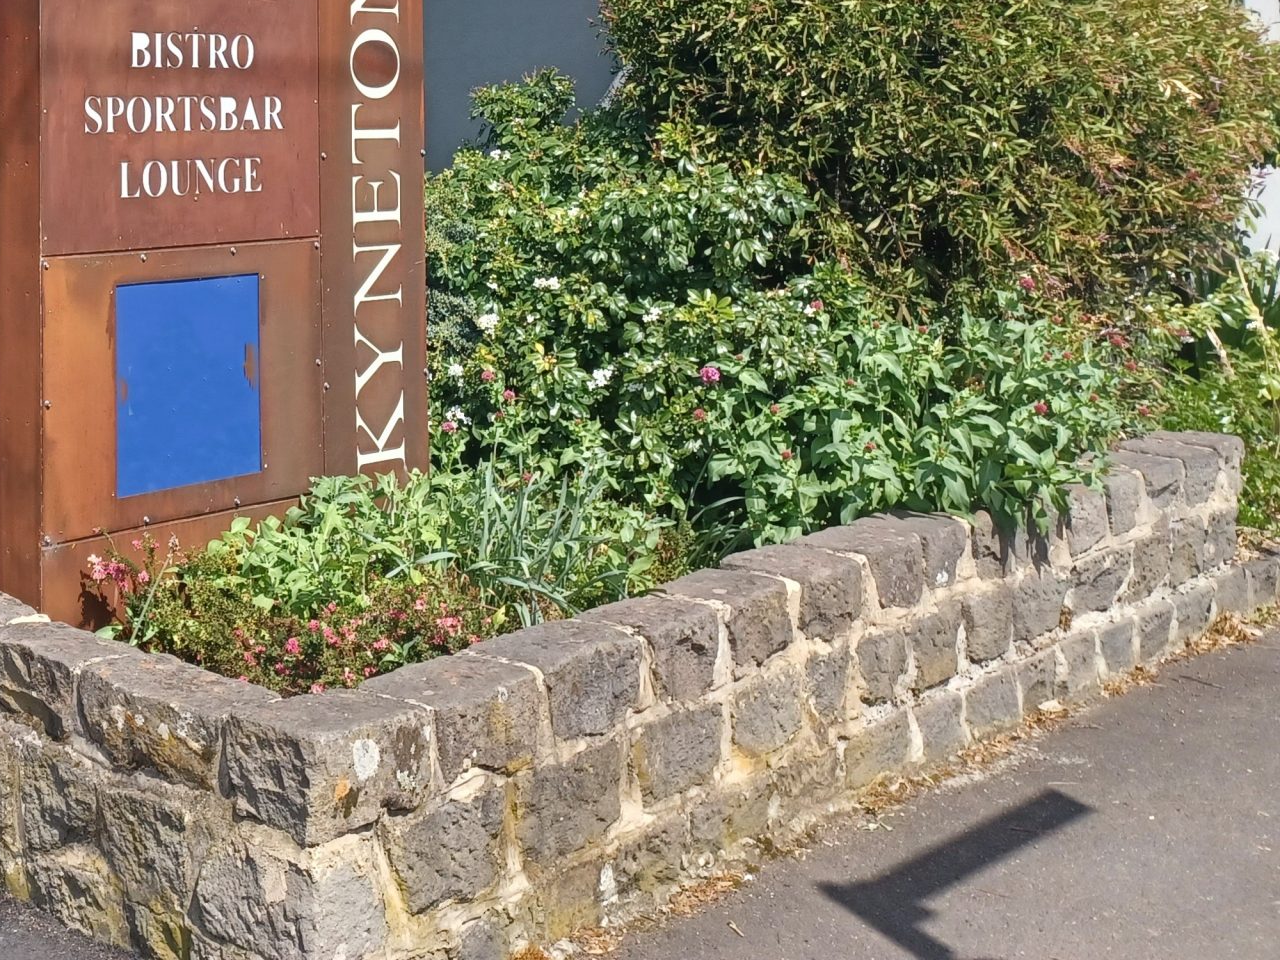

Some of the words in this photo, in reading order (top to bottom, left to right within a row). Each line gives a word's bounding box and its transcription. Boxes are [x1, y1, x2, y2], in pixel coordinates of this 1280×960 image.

[131, 31, 255, 69] BISTRO
[84, 96, 284, 134] SPORTSBAR
[120, 157, 262, 198] LOUNGE
